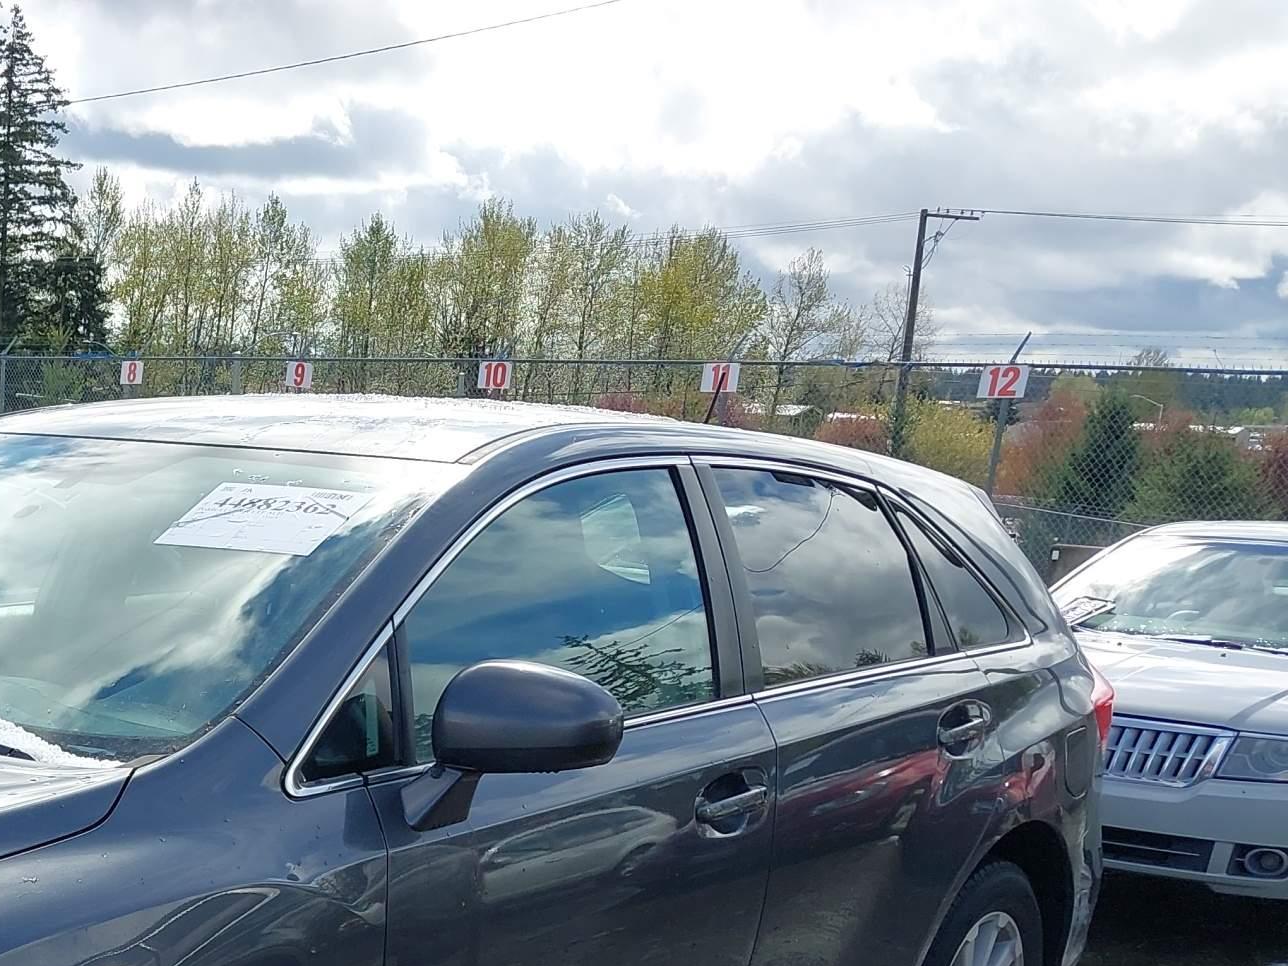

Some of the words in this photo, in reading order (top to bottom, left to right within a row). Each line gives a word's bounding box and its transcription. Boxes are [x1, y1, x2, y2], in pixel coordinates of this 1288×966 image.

[128, 362, 136, 383] 8
[294, 363, 305, 386] 9
[485, 363, 507, 387] 10
[712, 364, 730, 391] 11
[988, 367, 1020, 396] 12
[214, 496, 337, 515] 44882362
